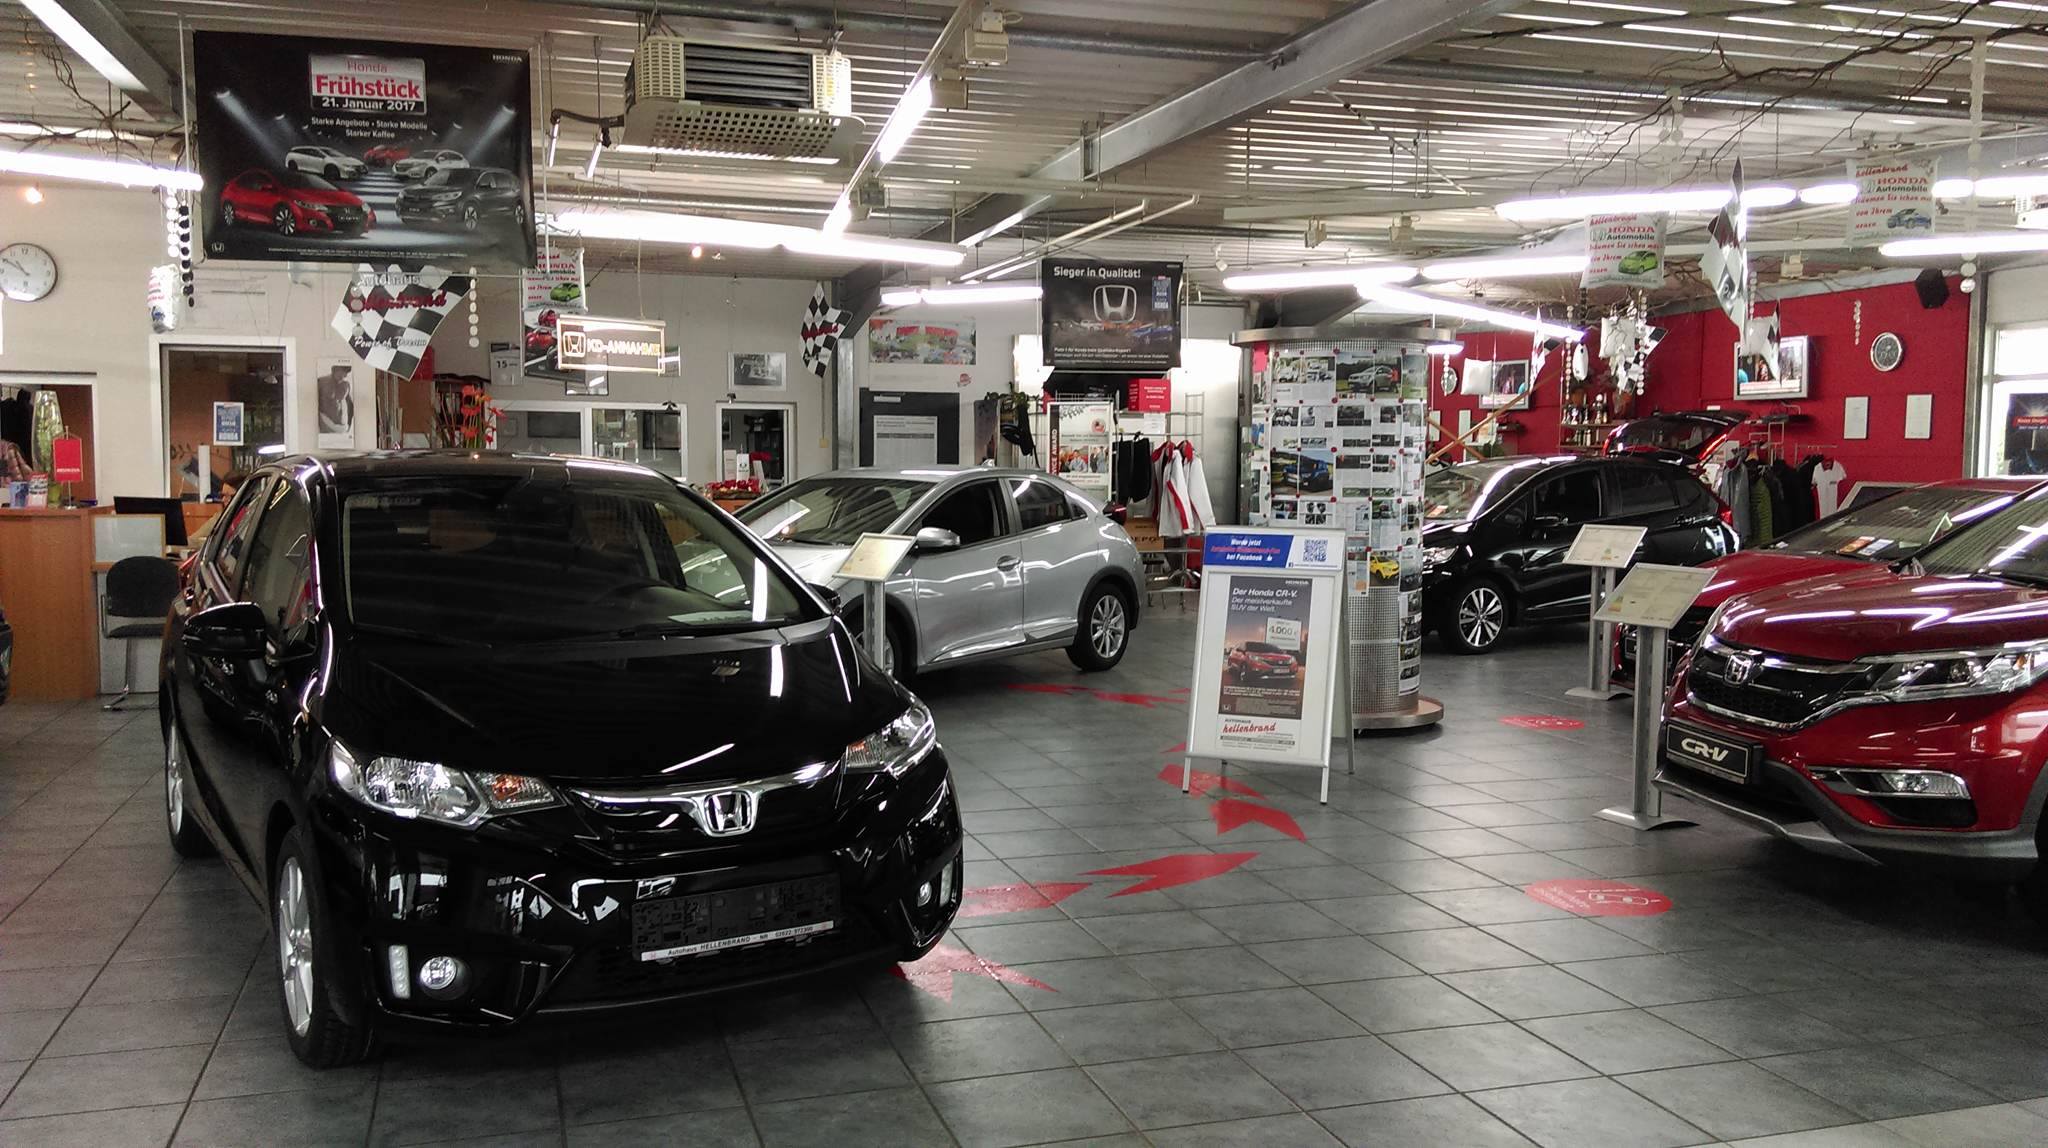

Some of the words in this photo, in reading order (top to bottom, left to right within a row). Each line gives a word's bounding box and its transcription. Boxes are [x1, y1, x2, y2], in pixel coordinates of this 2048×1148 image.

[347, 60, 388, 73] Honda
[316, 74, 421, 99] Frühstück
[322, 97, 339, 108] 21.
[342, 98, 383, 110] Januar
[387, 101, 416, 111] 2017
[311, 117, 334, 125] Starke
[335, 118, 370, 128] Angebote
[376, 120, 399, 128] Starke
[400, 122, 428, 130] Modelle
[345, 129, 371, 137] Starker
[372, 130, 395, 138] Kaffee
[1878, 177, 1929, 185] HONDA
[1876, 185, 1928, 193] Automobile
[1871, 207, 1893, 215] Ihrem
[1607, 233, 1655, 241] Automobile
[1603, 253, 1622, 261] Ihrem
[538, 262, 576, 270] HNDA
[1053, 266, 1085, 279] Sieger
[1087, 267, 1096, 277] in
[1098, 267, 1141, 279] Qualität!
[587, 338, 661, 356] KD-ANNAHME
[1232, 587, 1247, 596] Der
[1248, 588, 1274, 597] Honda
[1244, 597, 1292, 606] meistverkaufte
[1231, 604, 1246, 612] SUV
[1223, 721, 1277, 734] hellenbrand
[1681, 738, 1729, 762] CR-V
[668, 945, 697, 956] Autohaus
[700, 936, 751, 951] HELLENBRAND
